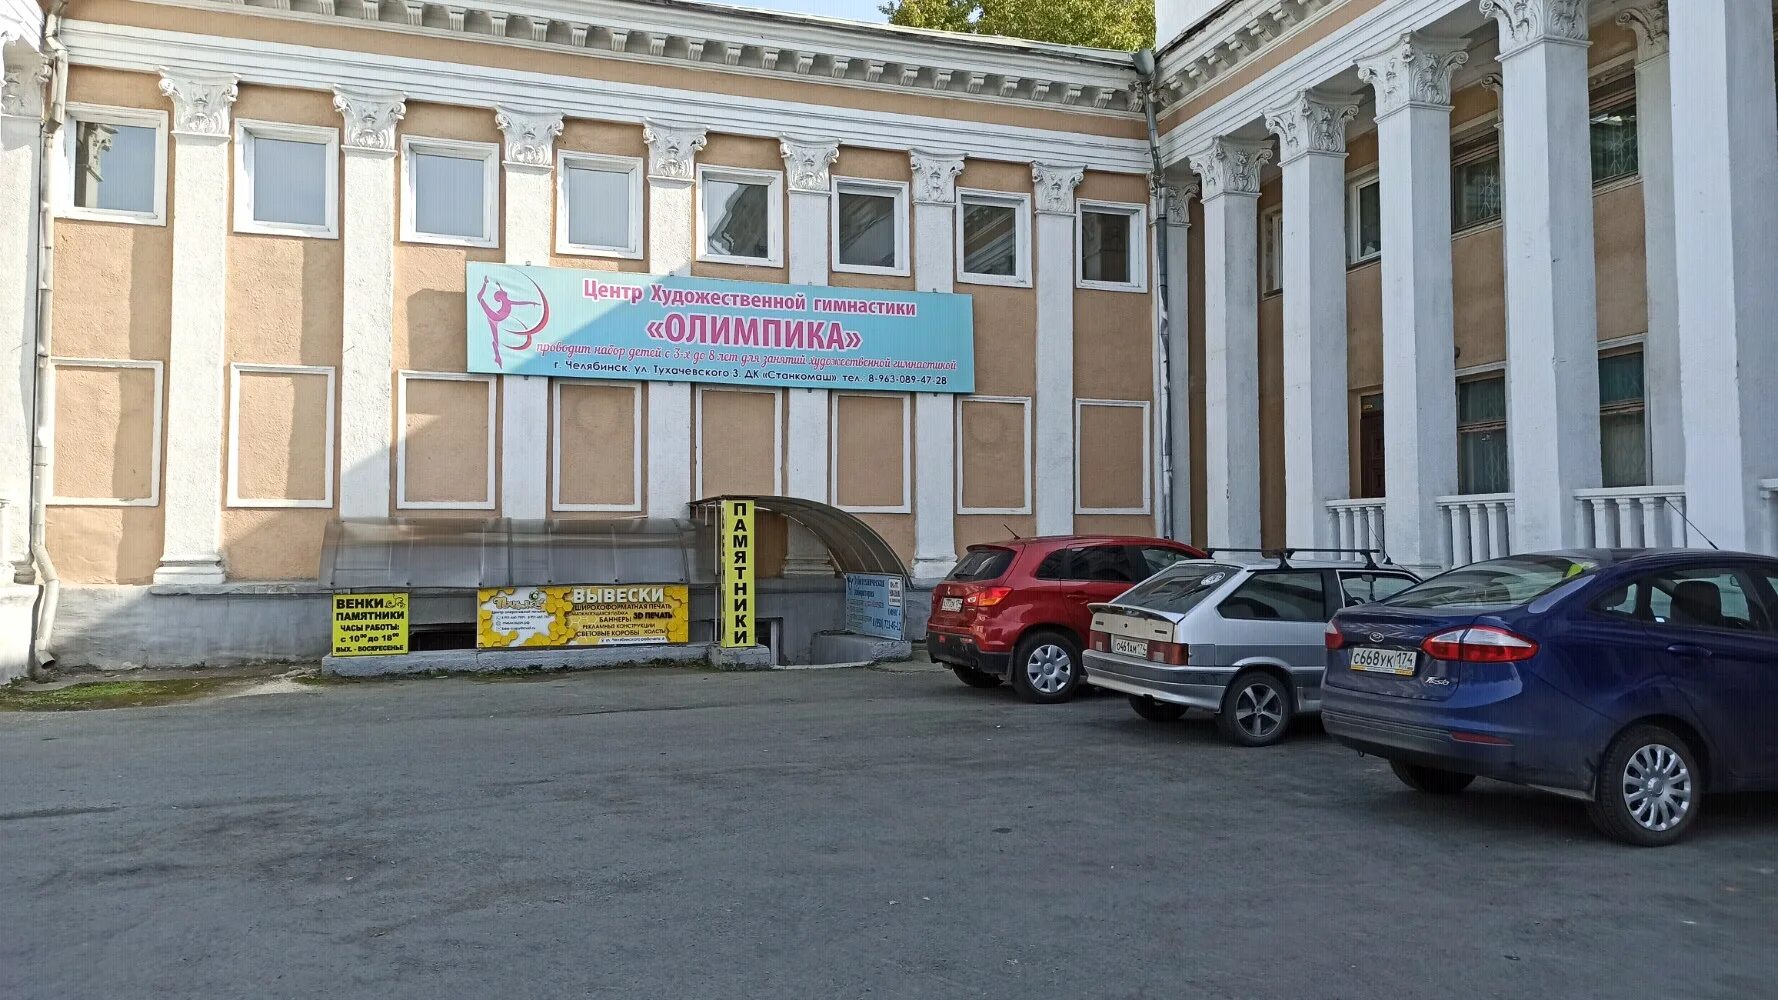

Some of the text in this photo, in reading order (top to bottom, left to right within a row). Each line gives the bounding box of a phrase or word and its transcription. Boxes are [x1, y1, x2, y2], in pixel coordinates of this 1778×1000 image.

[583, 279, 916, 315] Центр Художественной гимнастики
[648, 314, 862, 349] «ОЛИМПИКА»
[537, 341, 591, 358] проводит
[594, 344, 625, 360] набор
[628, 346, 661, 361] детей
[674, 347, 690, 360] 3-х
[693, 351, 706, 365] до
[708, 350, 715, 361] 8
[717, 353, 738, 362] лет
[741, 353, 760, 367] для
[761, 354, 806, 367] занятий
[808, 355, 891, 371] художественной
[893, 357, 957, 370] гимнастикой
[554, 361, 561, 369] г.
[634, 365, 649, 375] ул.
[654, 364, 729, 378] Тухачевского
[744, 369, 759, 379] ДК
[868, 374, 947, 385] 8-963-089-47-28
[732, 502, 748, 644] ПАМЯТНИКИ
[336, 598, 384, 609] ВЕНКИ
[573, 587, 664, 604] ВЫВЕСКИ
[336, 611, 405, 621] ПАМЯТНИКИ
[645, 611, 673, 619] ПЕЧАТЬ
[1396, 652, 1413, 666] 174
